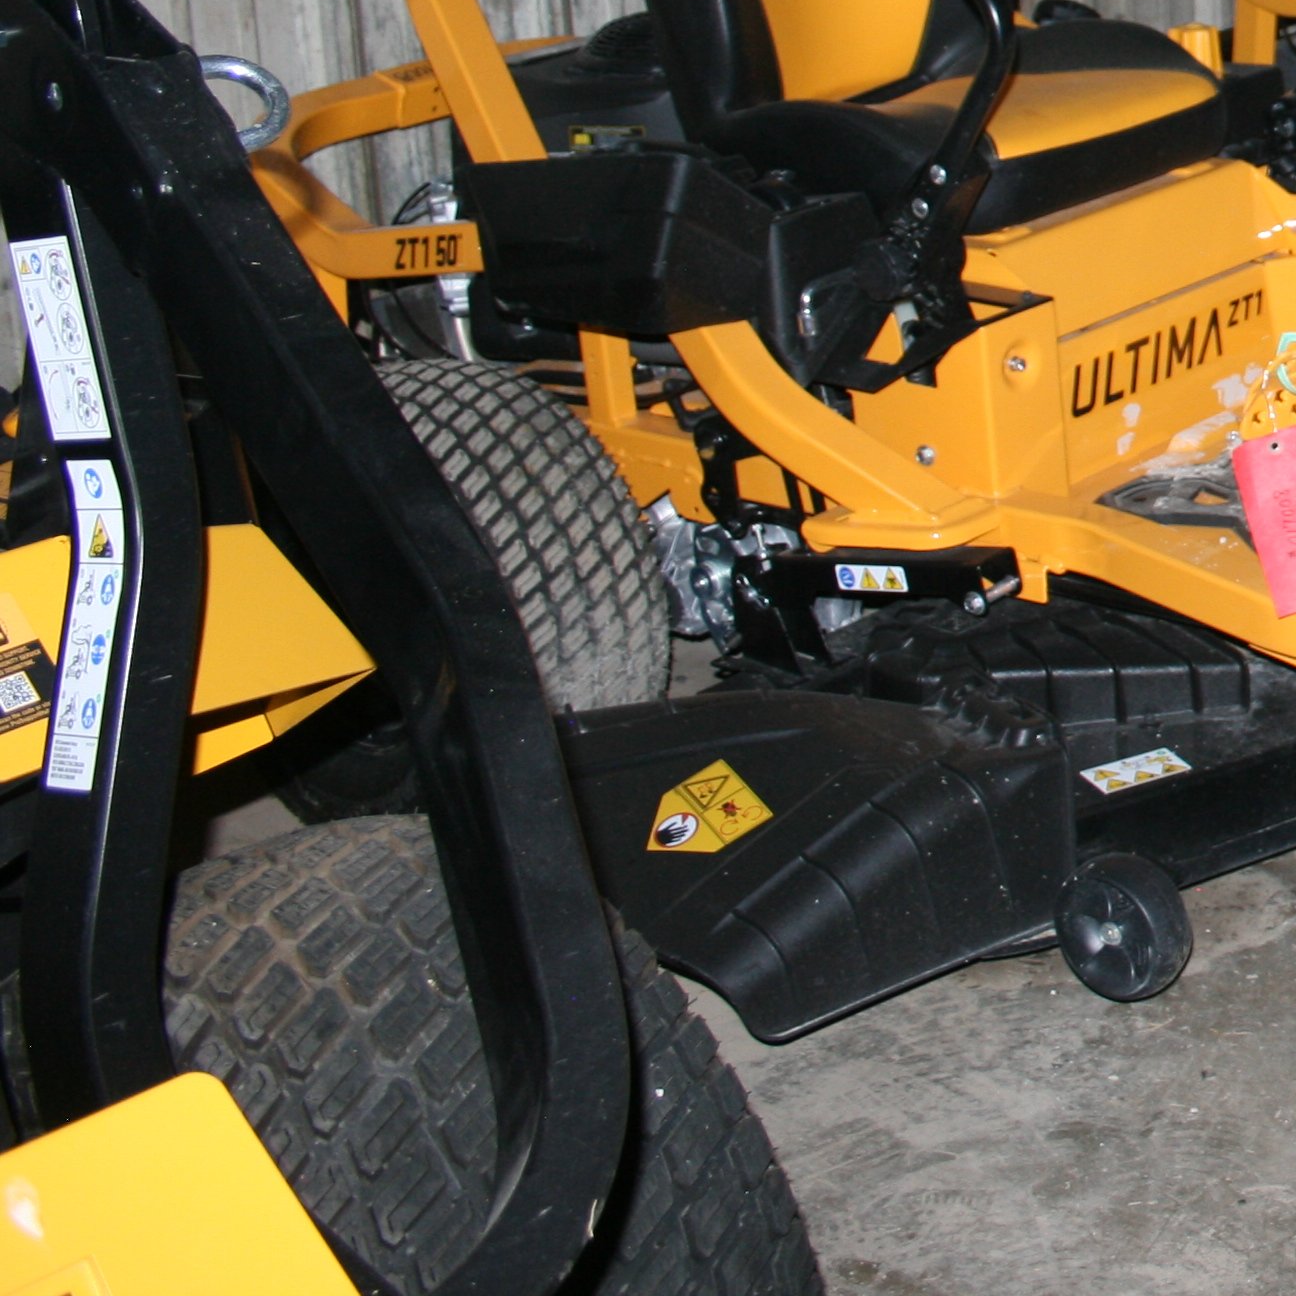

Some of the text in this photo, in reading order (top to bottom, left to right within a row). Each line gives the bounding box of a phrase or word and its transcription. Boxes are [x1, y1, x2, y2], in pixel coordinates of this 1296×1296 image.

[395, 235, 430, 271] ZT1
[1071, 288, 1263, 418] ULTIMA ZT1
